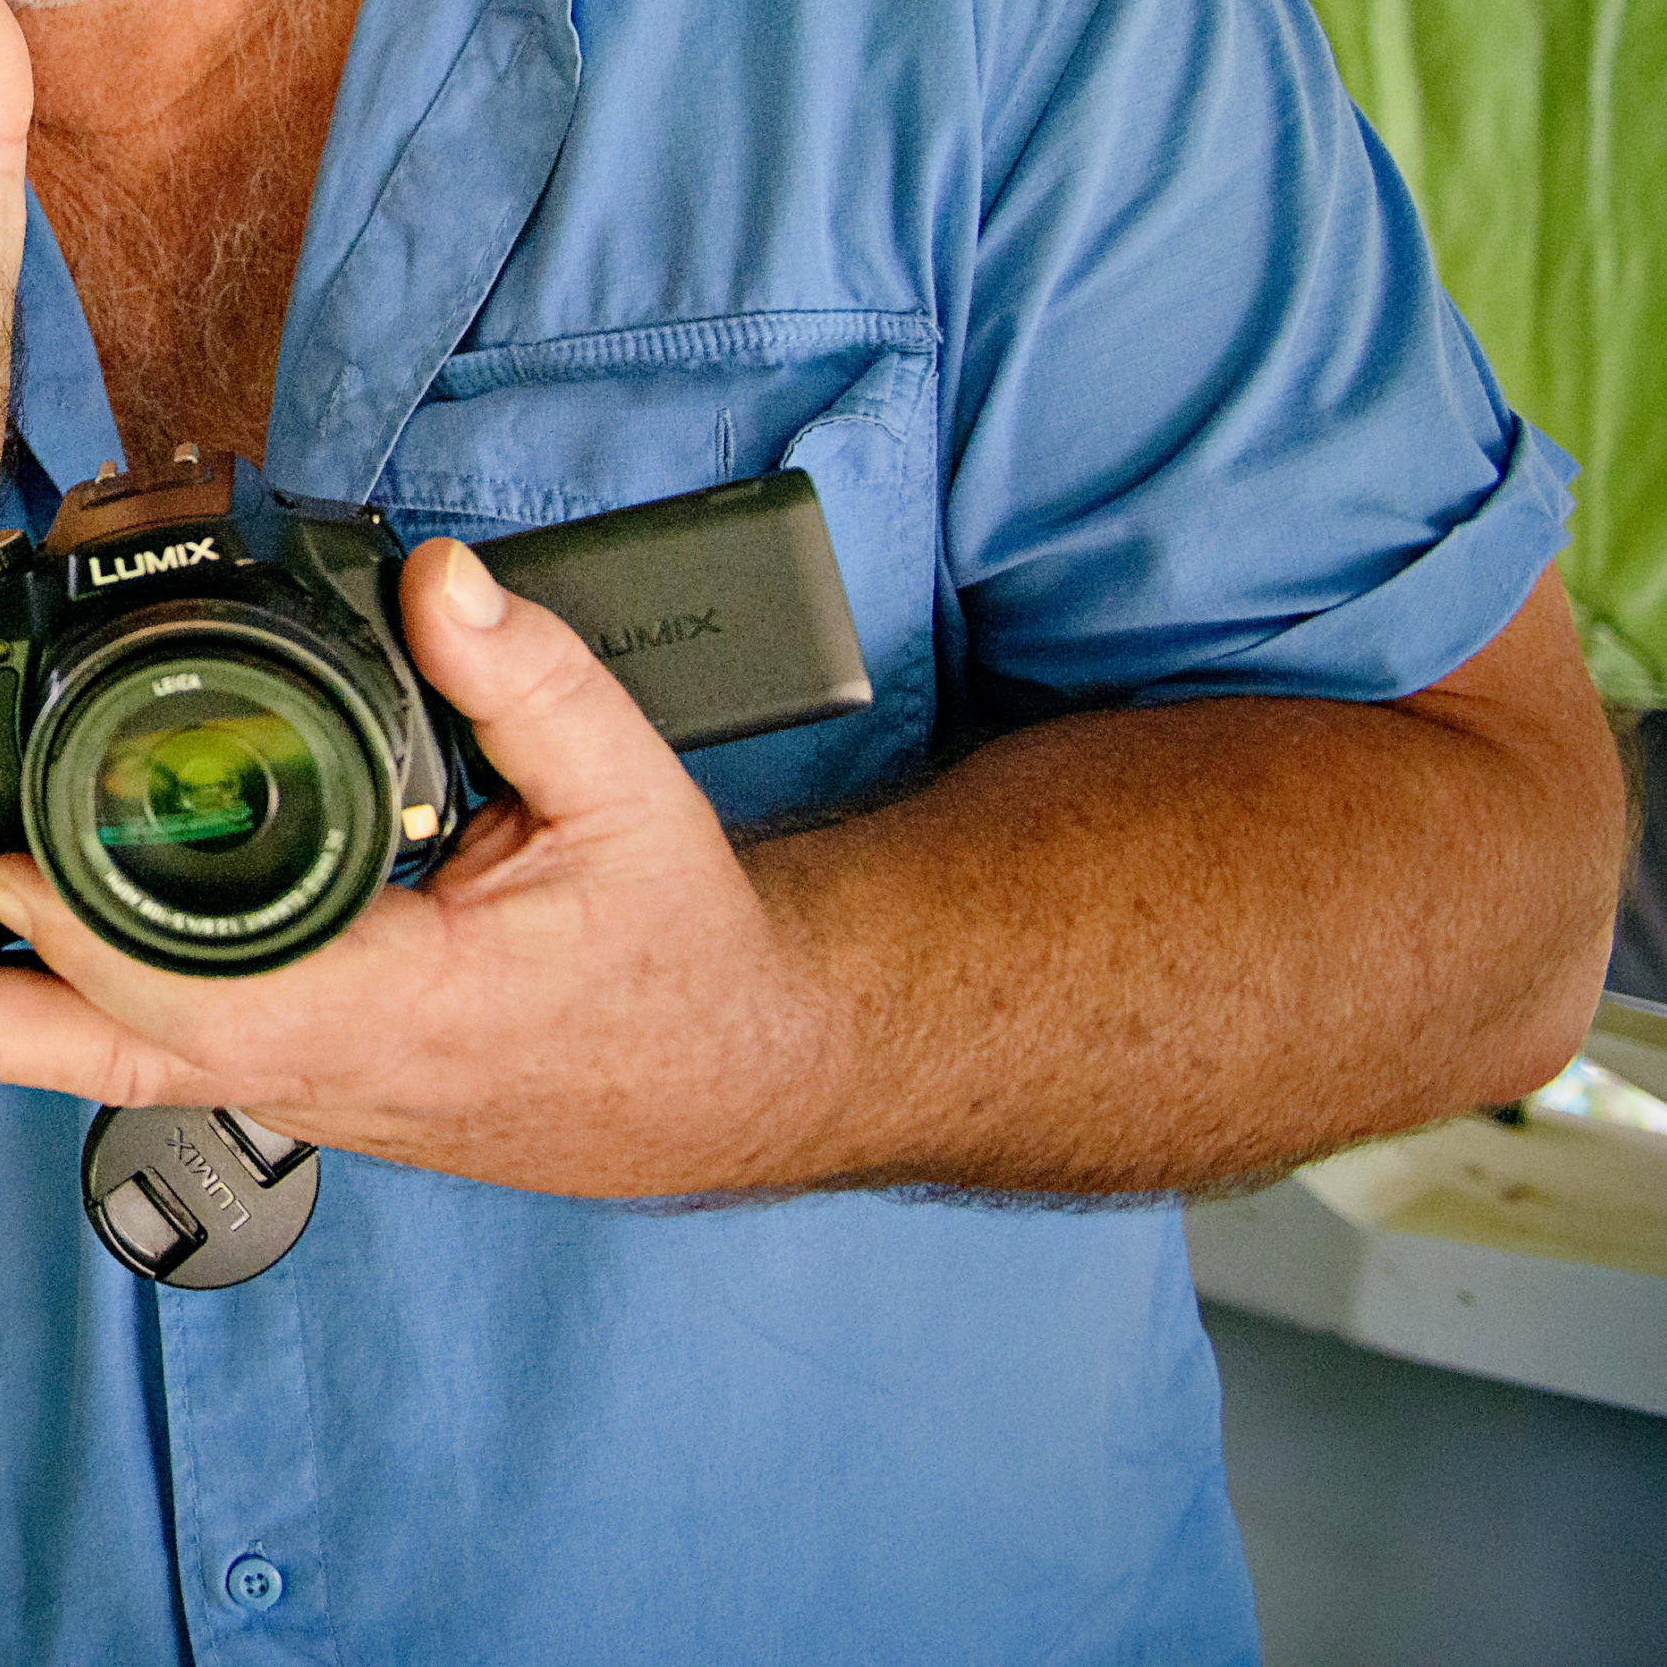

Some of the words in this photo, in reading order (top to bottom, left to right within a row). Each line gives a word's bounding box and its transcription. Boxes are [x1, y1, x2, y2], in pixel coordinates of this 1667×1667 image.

[88, 537, 220, 586] LUMIX
[594, 607, 723, 659] UMIX
[167, 1126, 252, 1232] LUMIX
